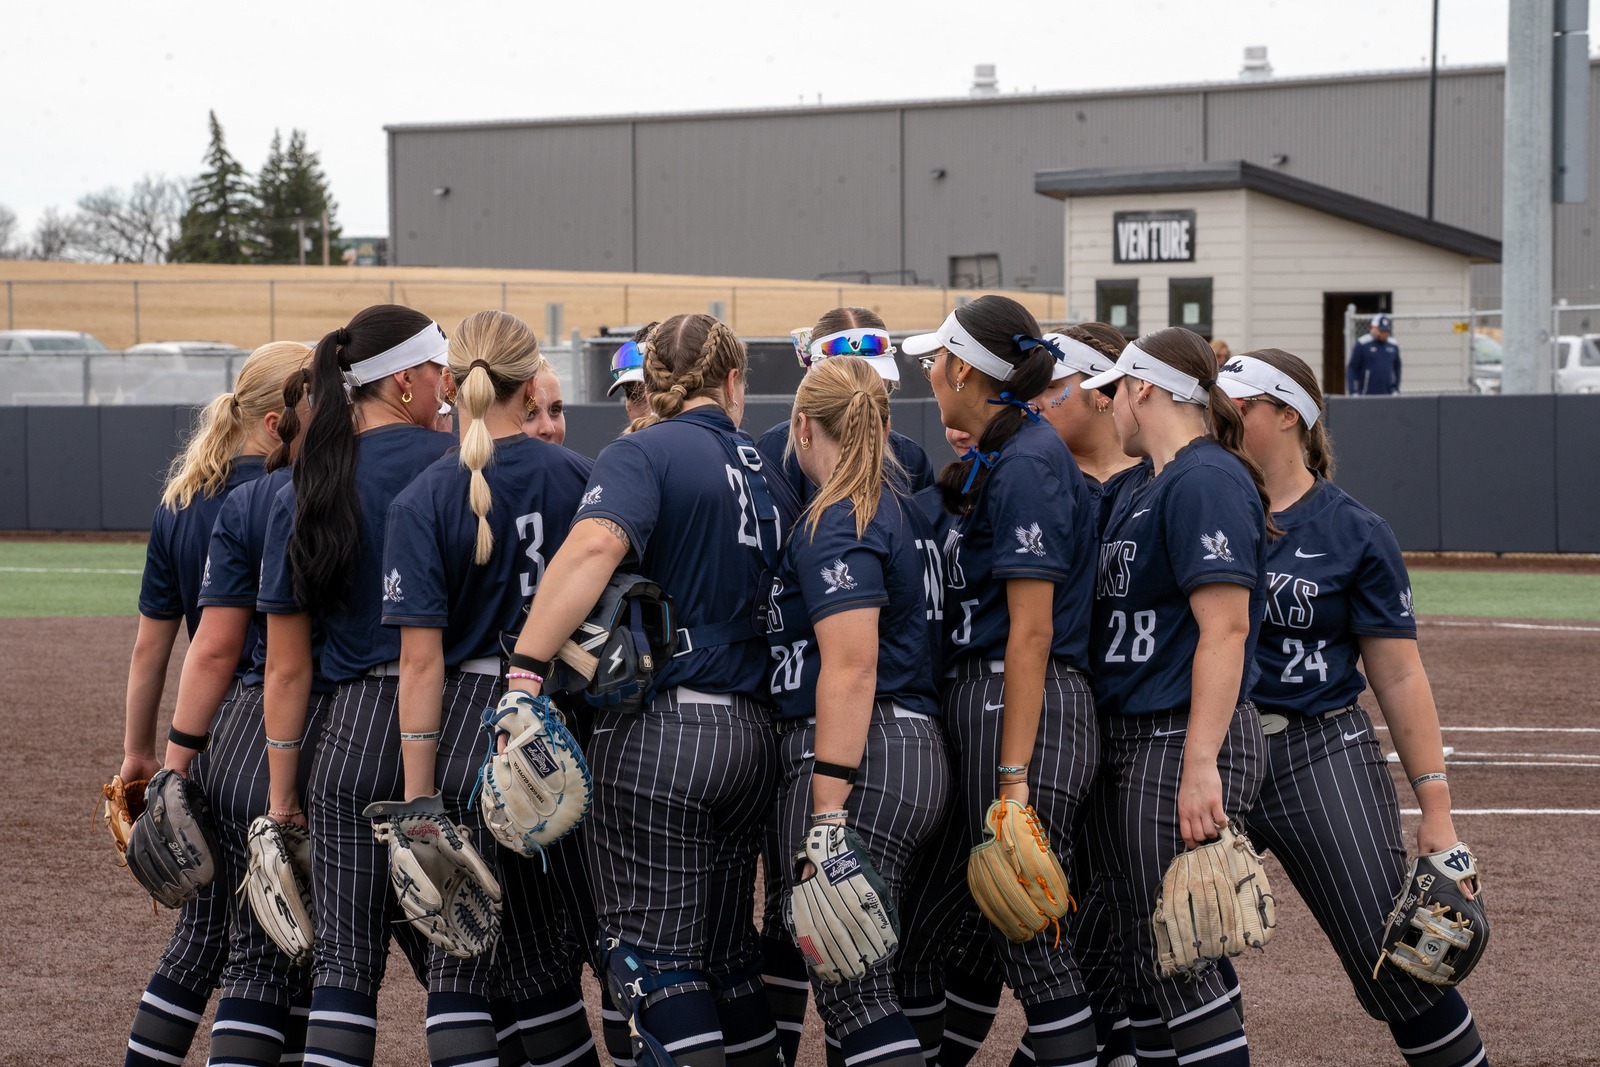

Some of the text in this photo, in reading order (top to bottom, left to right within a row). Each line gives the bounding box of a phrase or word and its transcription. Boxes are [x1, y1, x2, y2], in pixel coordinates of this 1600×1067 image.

[1117, 220, 1190, 260] VENTURE
[515, 511, 545, 597] 3
[1105, 609, 1156, 663] 28
[1281, 638, 1328, 683] 24
[770, 639, 808, 694] 20
